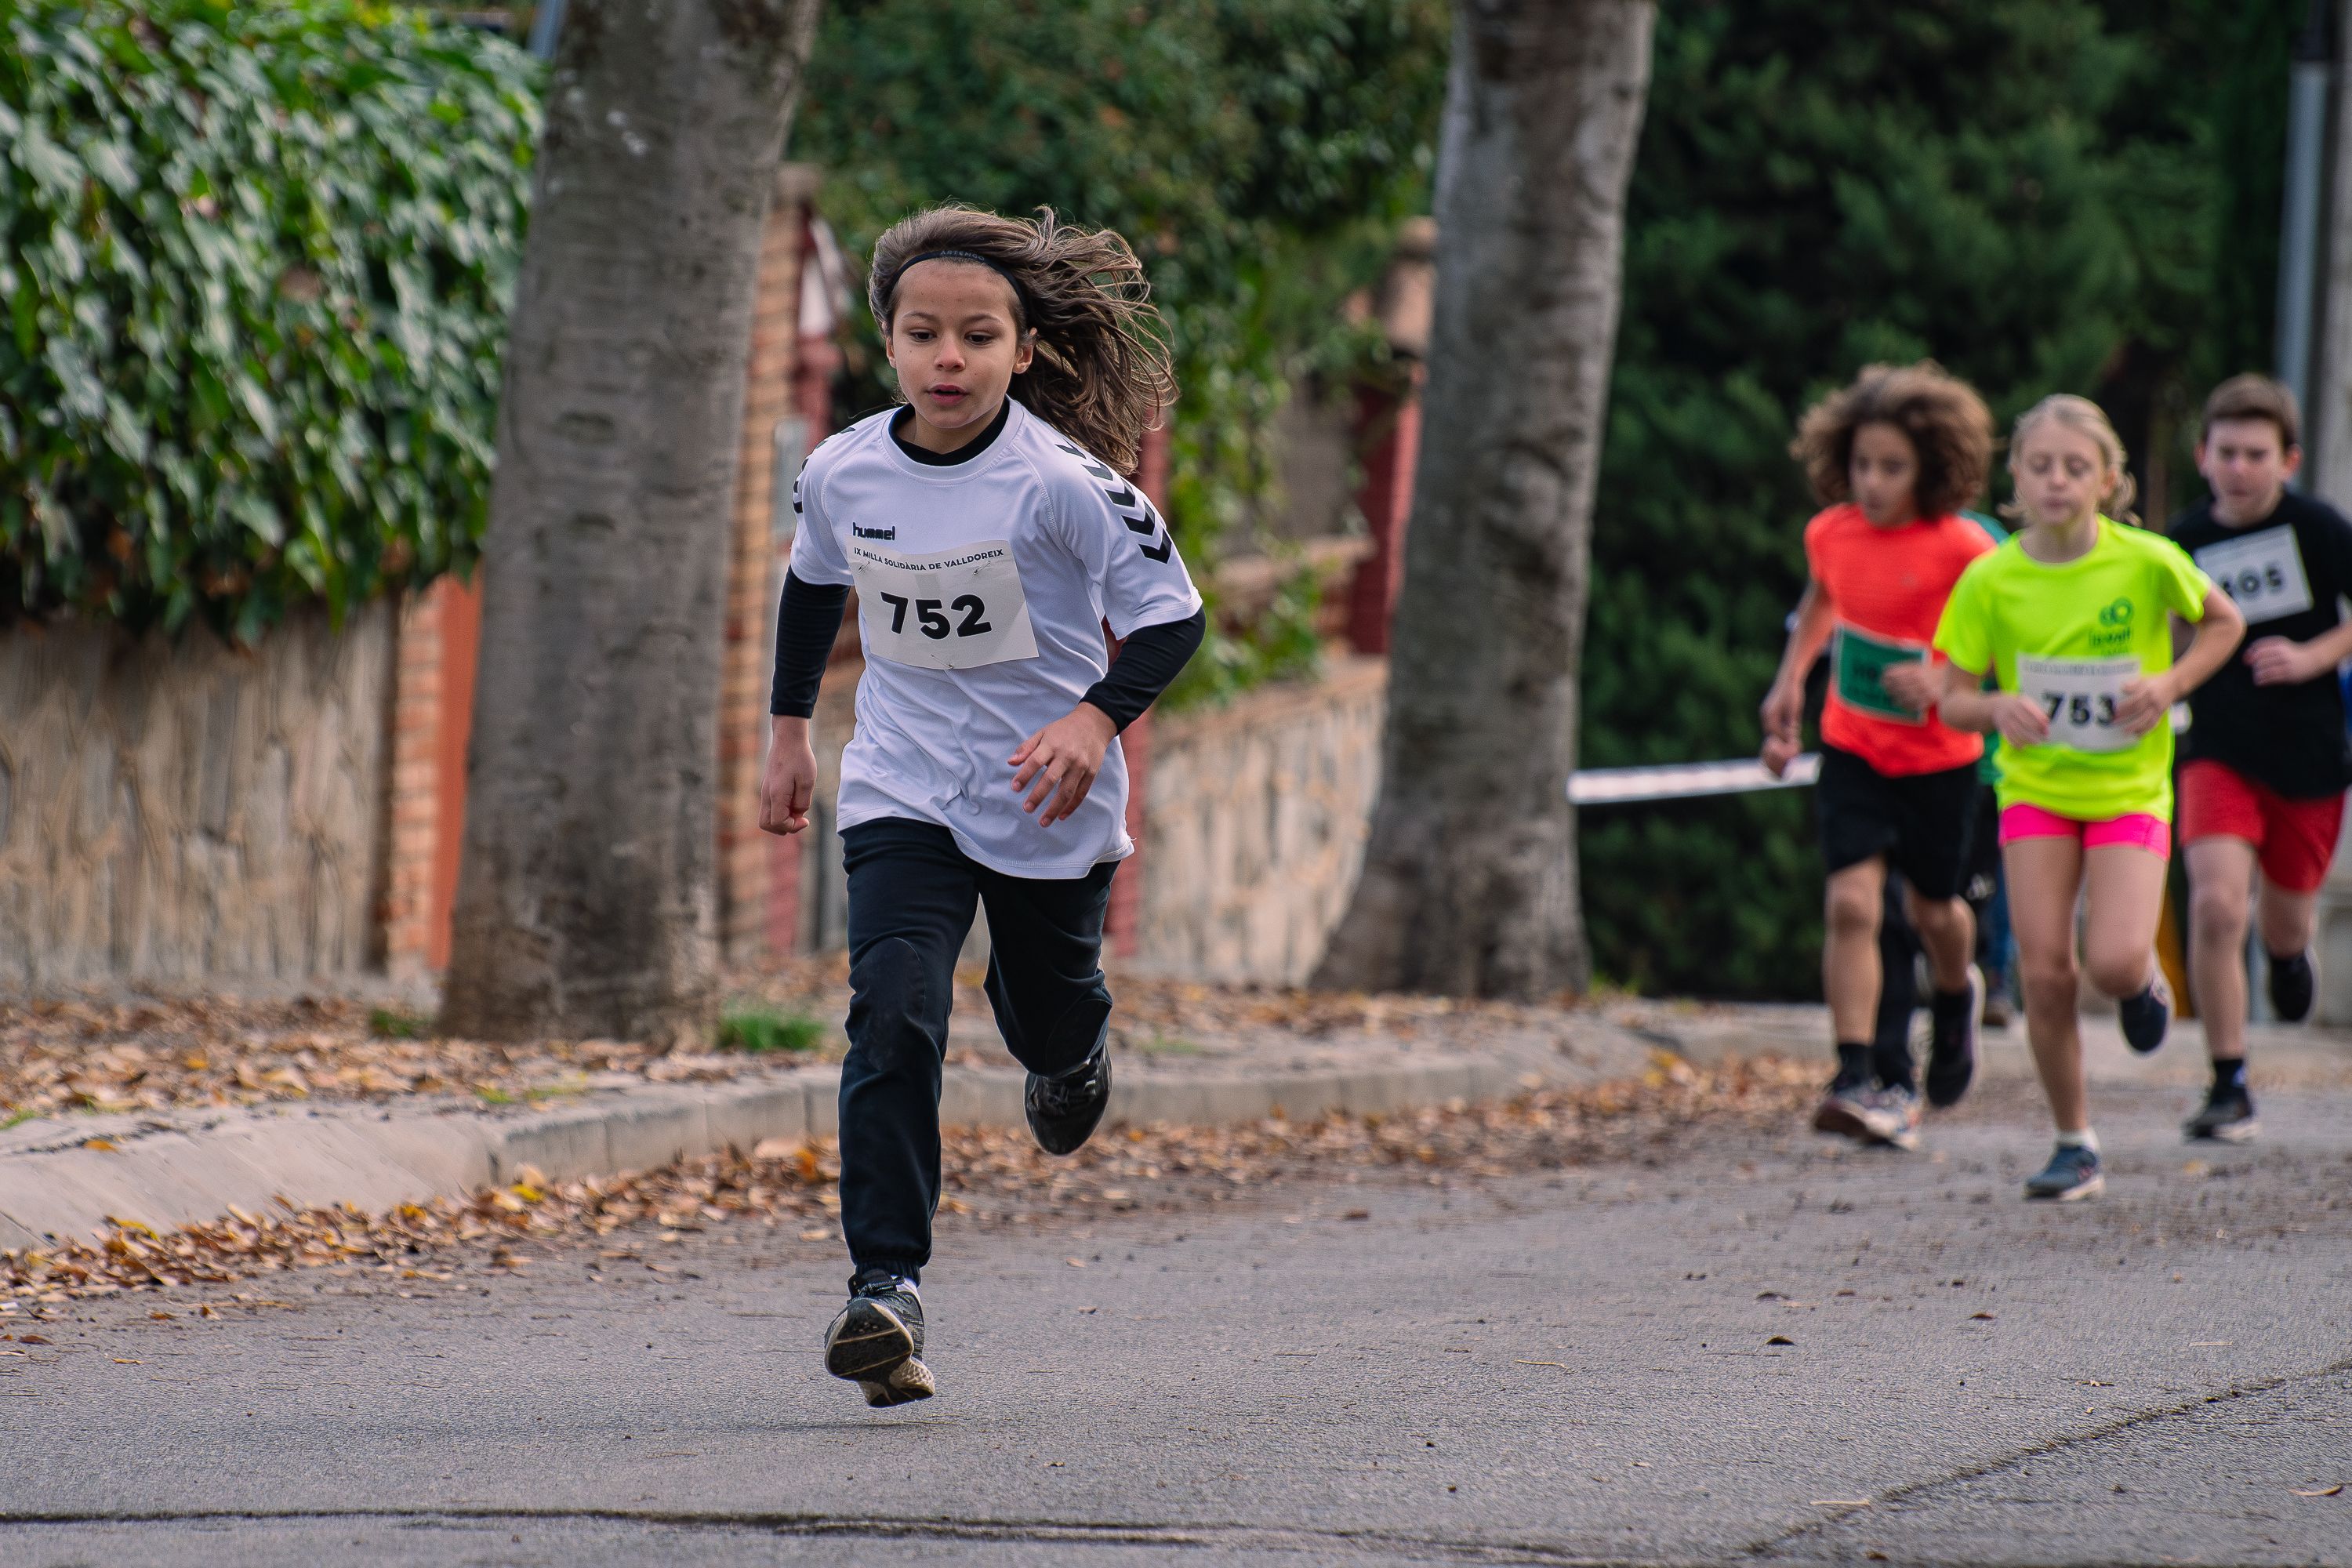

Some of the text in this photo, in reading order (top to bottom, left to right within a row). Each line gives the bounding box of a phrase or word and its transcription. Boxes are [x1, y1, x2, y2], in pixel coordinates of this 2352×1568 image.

[940, 250, 985, 261] ARTENGO
[852, 521, 895, 541] hummel
[854, 546, 862, 556] IX
[862, 550, 883, 563] MILLA
[884, 557, 927, 571] SOLIDÀRIA
[943, 549, 1004, 568] VALLDOREIX
[880, 591, 993, 640] 752
[2042, 688, 2114, 728] 753
